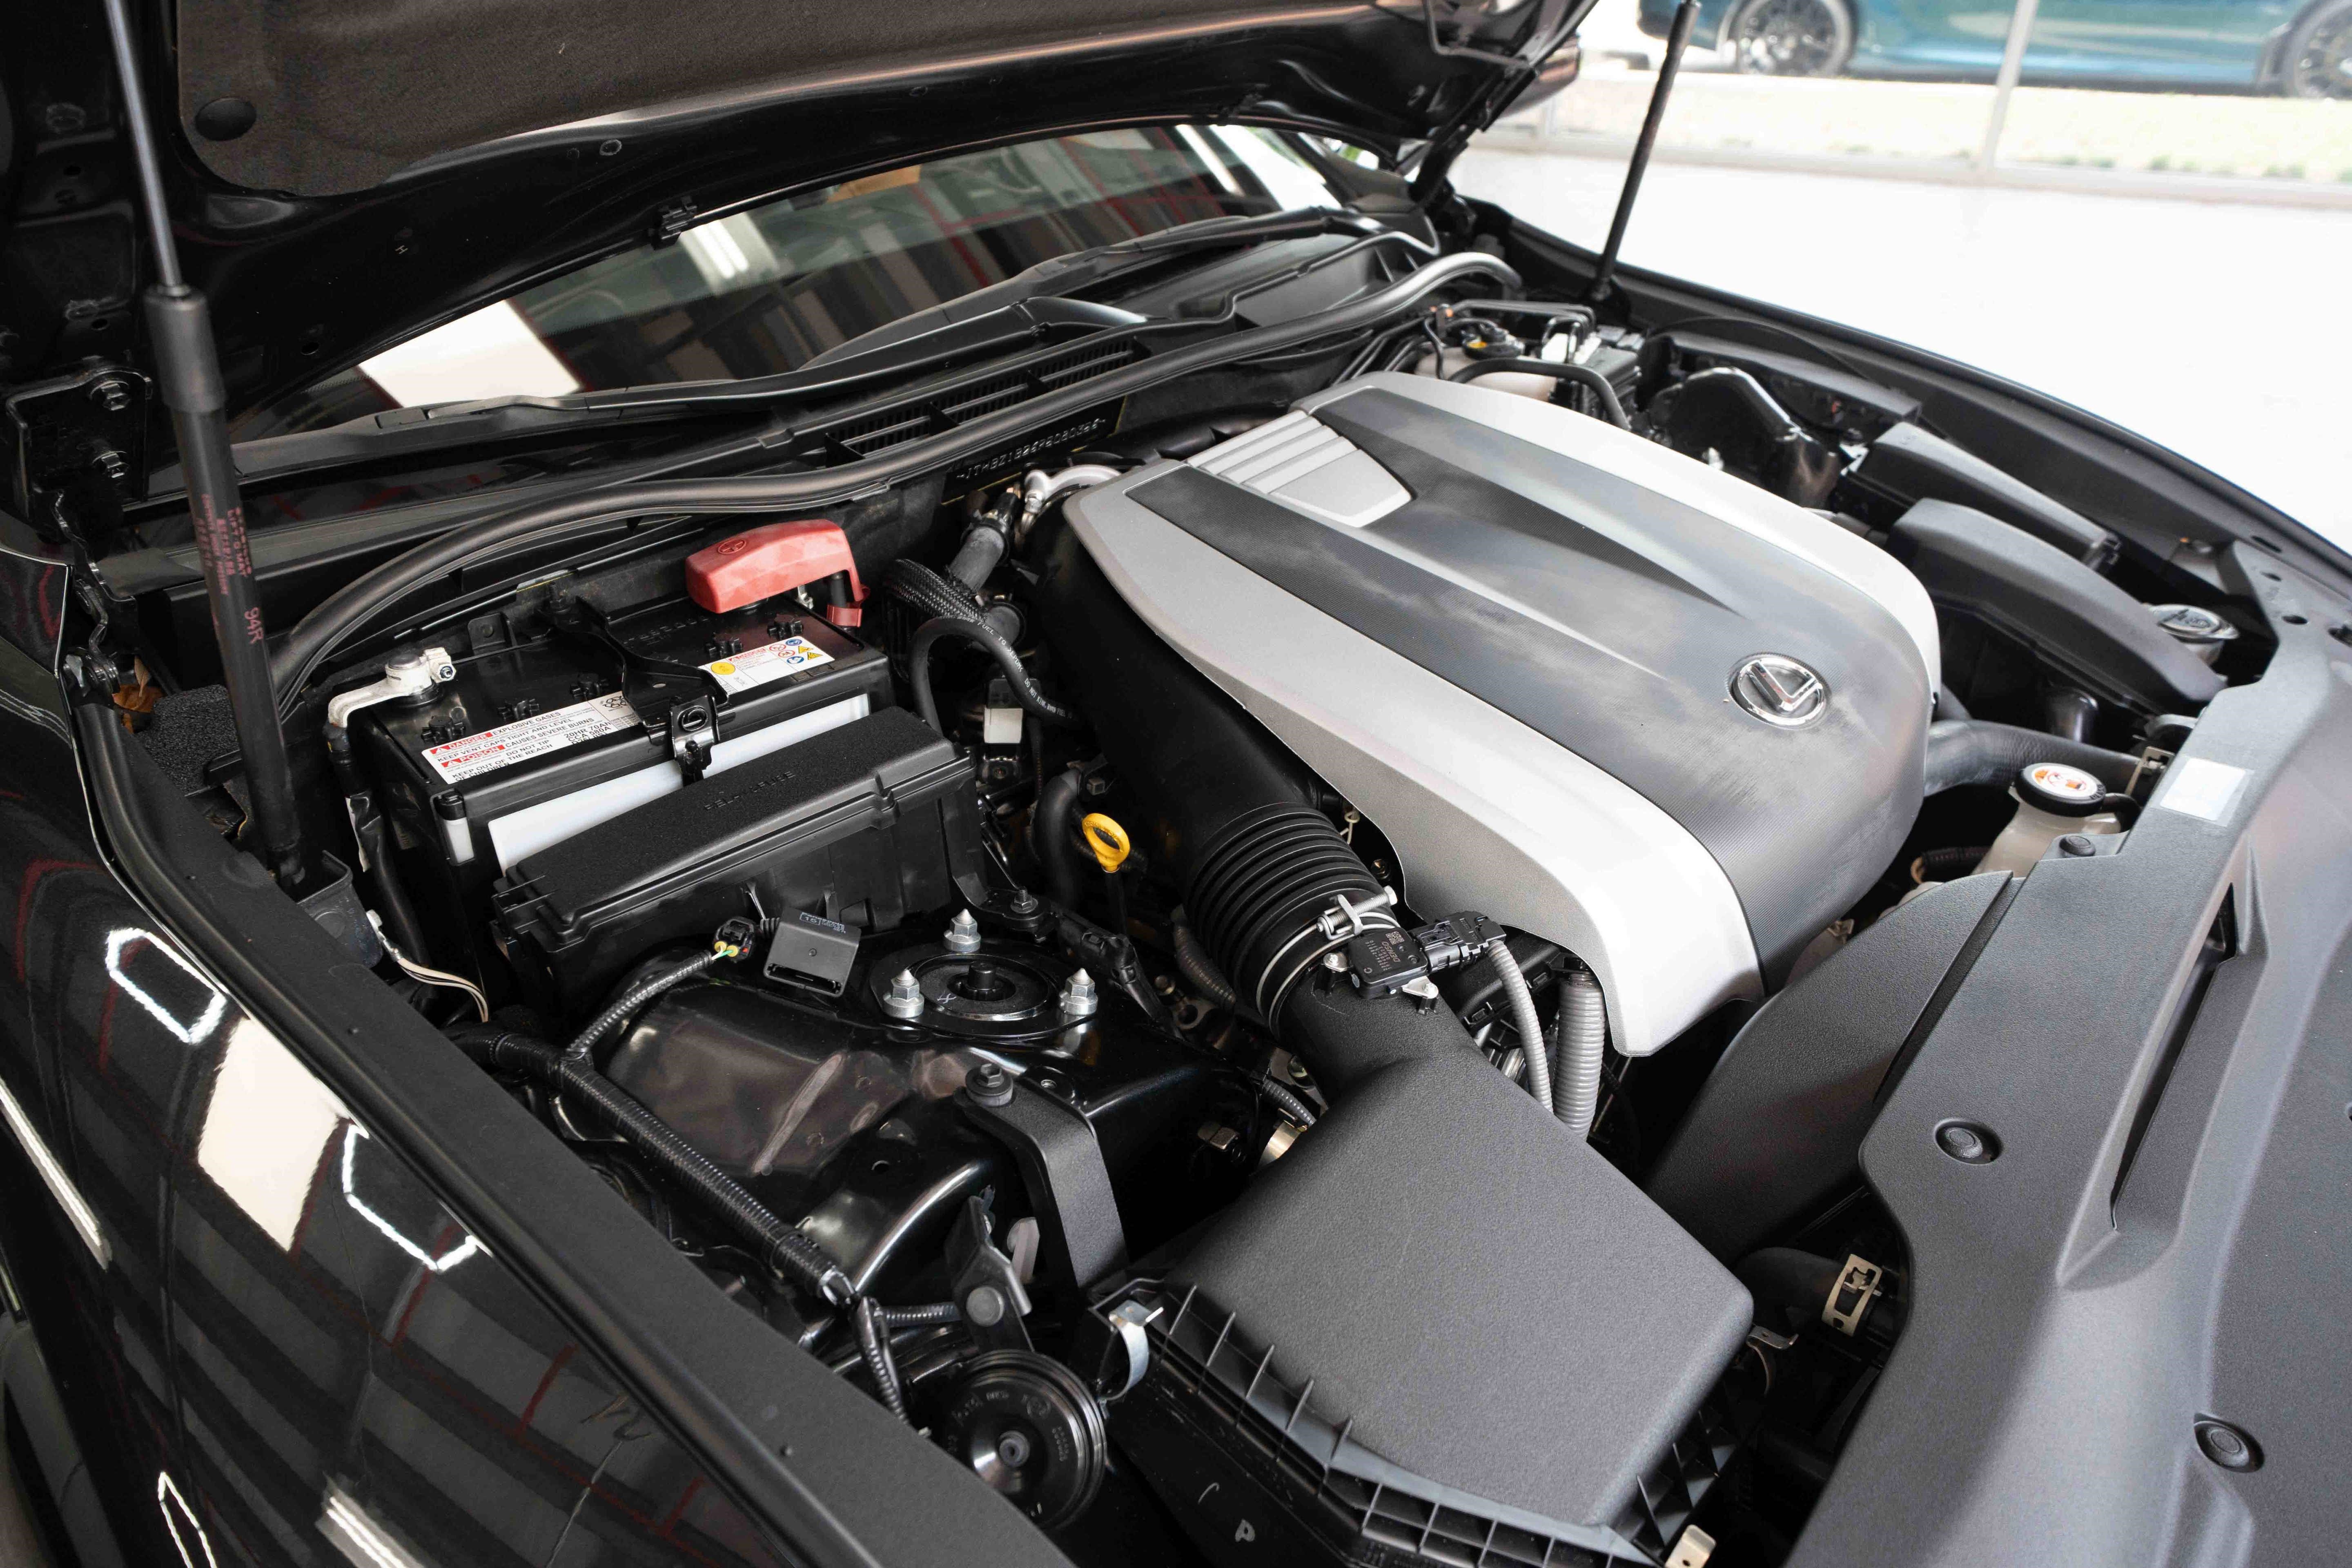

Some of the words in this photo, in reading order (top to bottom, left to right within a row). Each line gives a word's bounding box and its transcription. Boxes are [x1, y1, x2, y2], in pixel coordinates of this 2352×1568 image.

[245, 607, 264, 645] 94R
[977, 621, 994, 635] FUEL
[1024, 677, 1031, 688] DO
[1029, 686, 1037, 698] NOT
[437, 753, 460, 762] KEEP
[460, 746, 481, 755] VENT
[484, 738, 506, 748] CAPS
[508, 731, 530, 740] TIGHT
[551, 719, 572, 727] LEVEL
[449, 734, 487, 749] DANGER
[493, 720, 536, 735] EXPLOSIVE
[537, 712, 561, 722] GASES
[460, 747, 500, 762] POISON
[505, 735, 537, 747] CAUSES
[537, 726, 568, 738] SEVERE
[568, 717, 595, 728] BURNS
[565, 728, 588, 738] 20HR
[590, 722, 612, 730] 70Ah
[568, 733, 589, 742] CCA
[589, 726, 612, 735] 580A
[519, 743, 539, 752] NOT
[452, 768, 474, 778] KEEP
[508, 753, 525, 761] THE
[526, 744, 553, 755] REACH
[1381, 941, 1401, 962] DENSO
